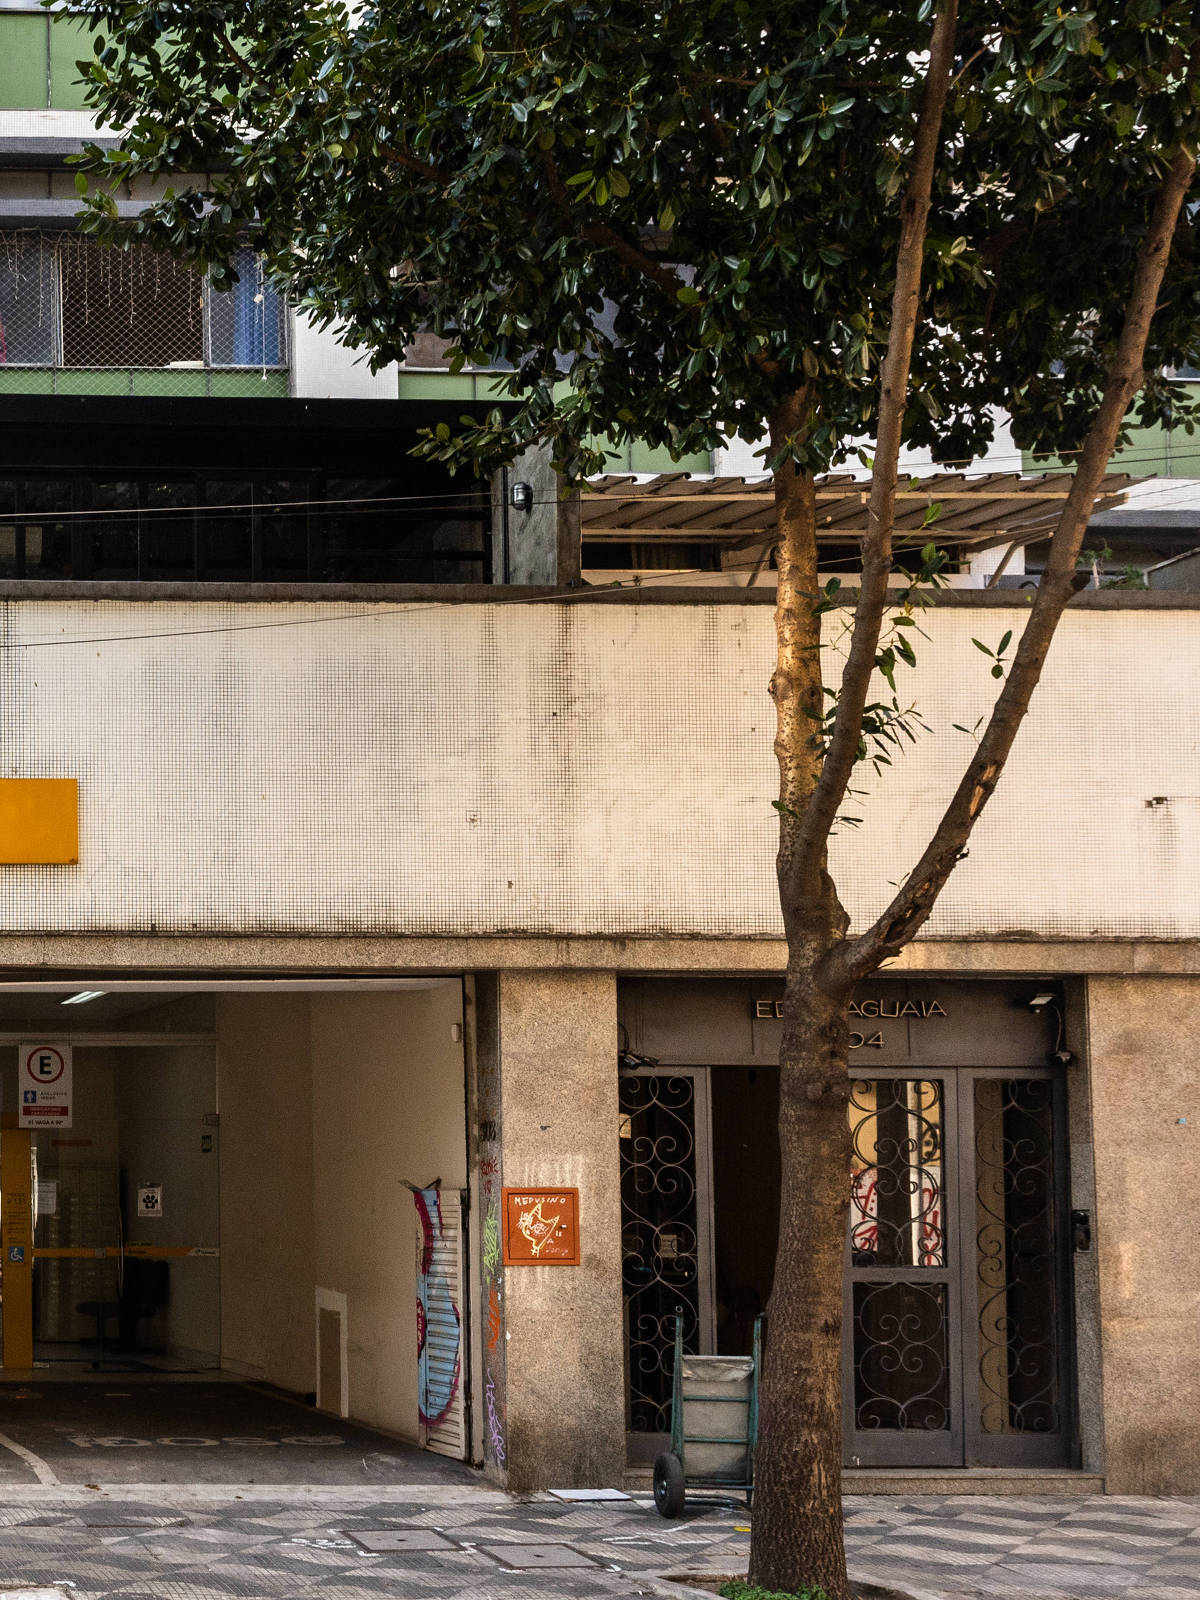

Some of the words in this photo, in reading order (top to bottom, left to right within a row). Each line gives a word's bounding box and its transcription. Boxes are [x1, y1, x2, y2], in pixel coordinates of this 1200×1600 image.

[847, 999, 949, 1019] AGUAIA
[847, 1031, 886, 1050] 04
[39, 1055, 52, 1075] E
